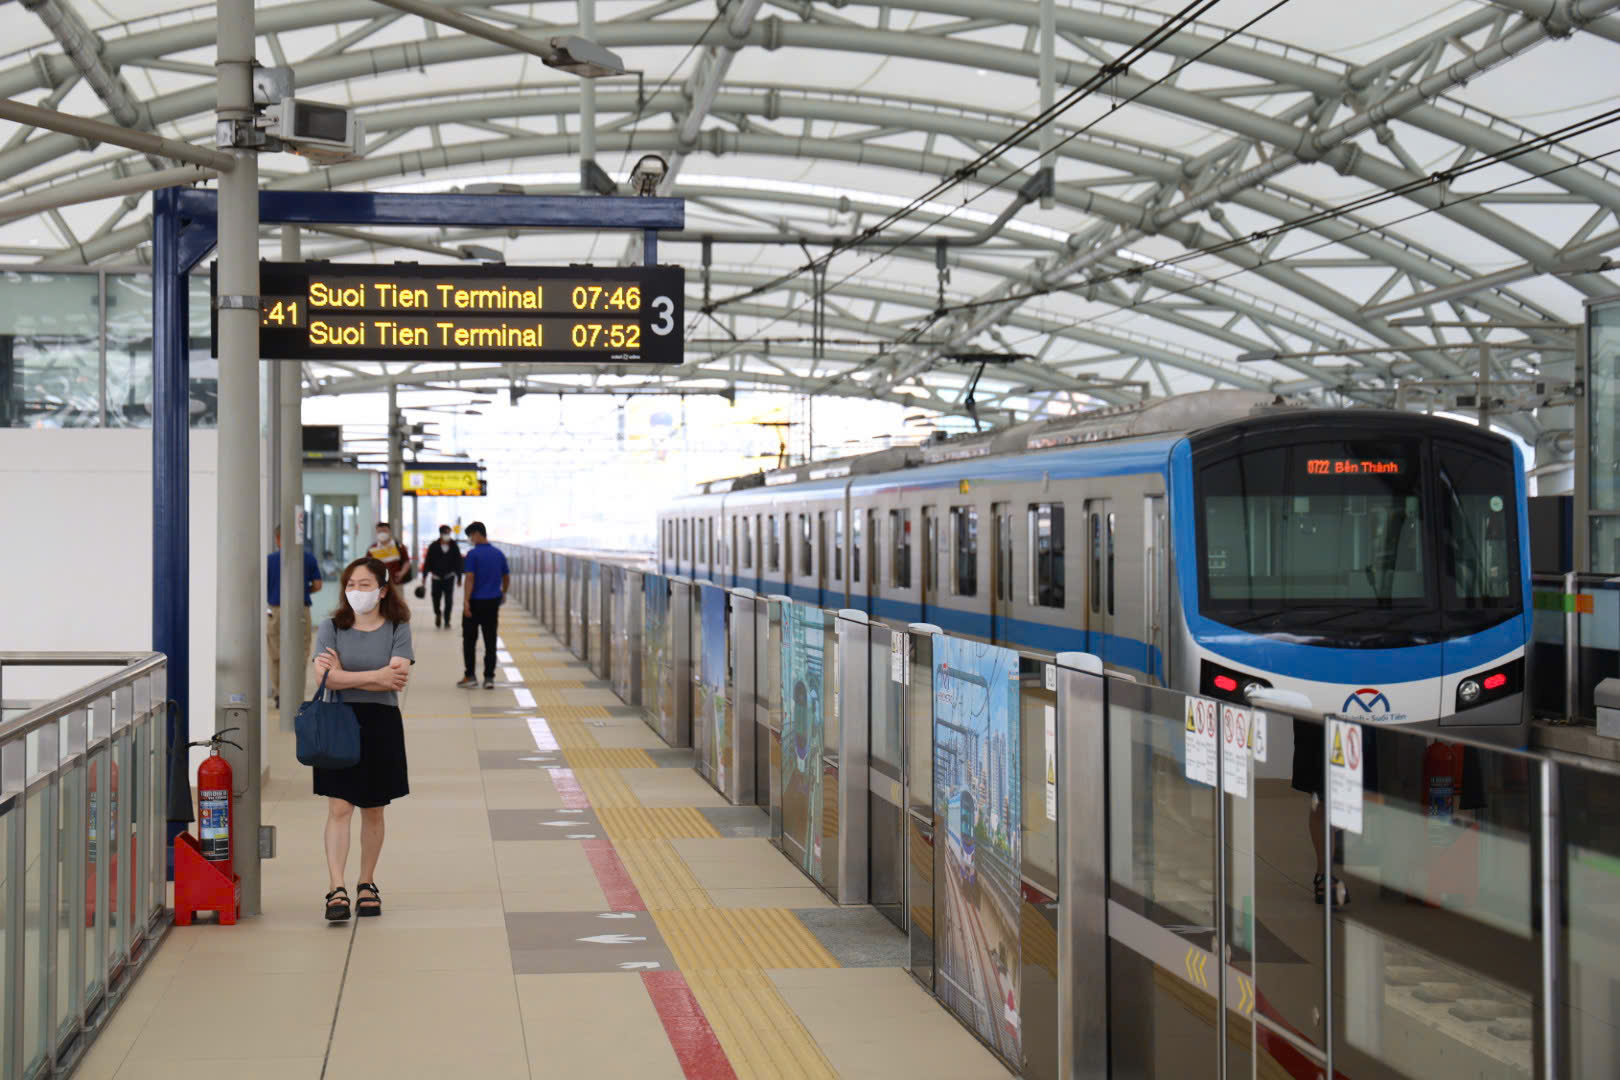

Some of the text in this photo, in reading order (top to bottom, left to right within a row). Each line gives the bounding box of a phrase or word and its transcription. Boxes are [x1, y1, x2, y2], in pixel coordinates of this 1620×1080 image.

[308, 282, 641, 310] Suoi Tien Terminal 07:46
[650, 296, 675, 336] 3
[308, 321, 641, 348] Suoi Tien Terminal 07:52
[1307, 460, 1330, 474] 0722
